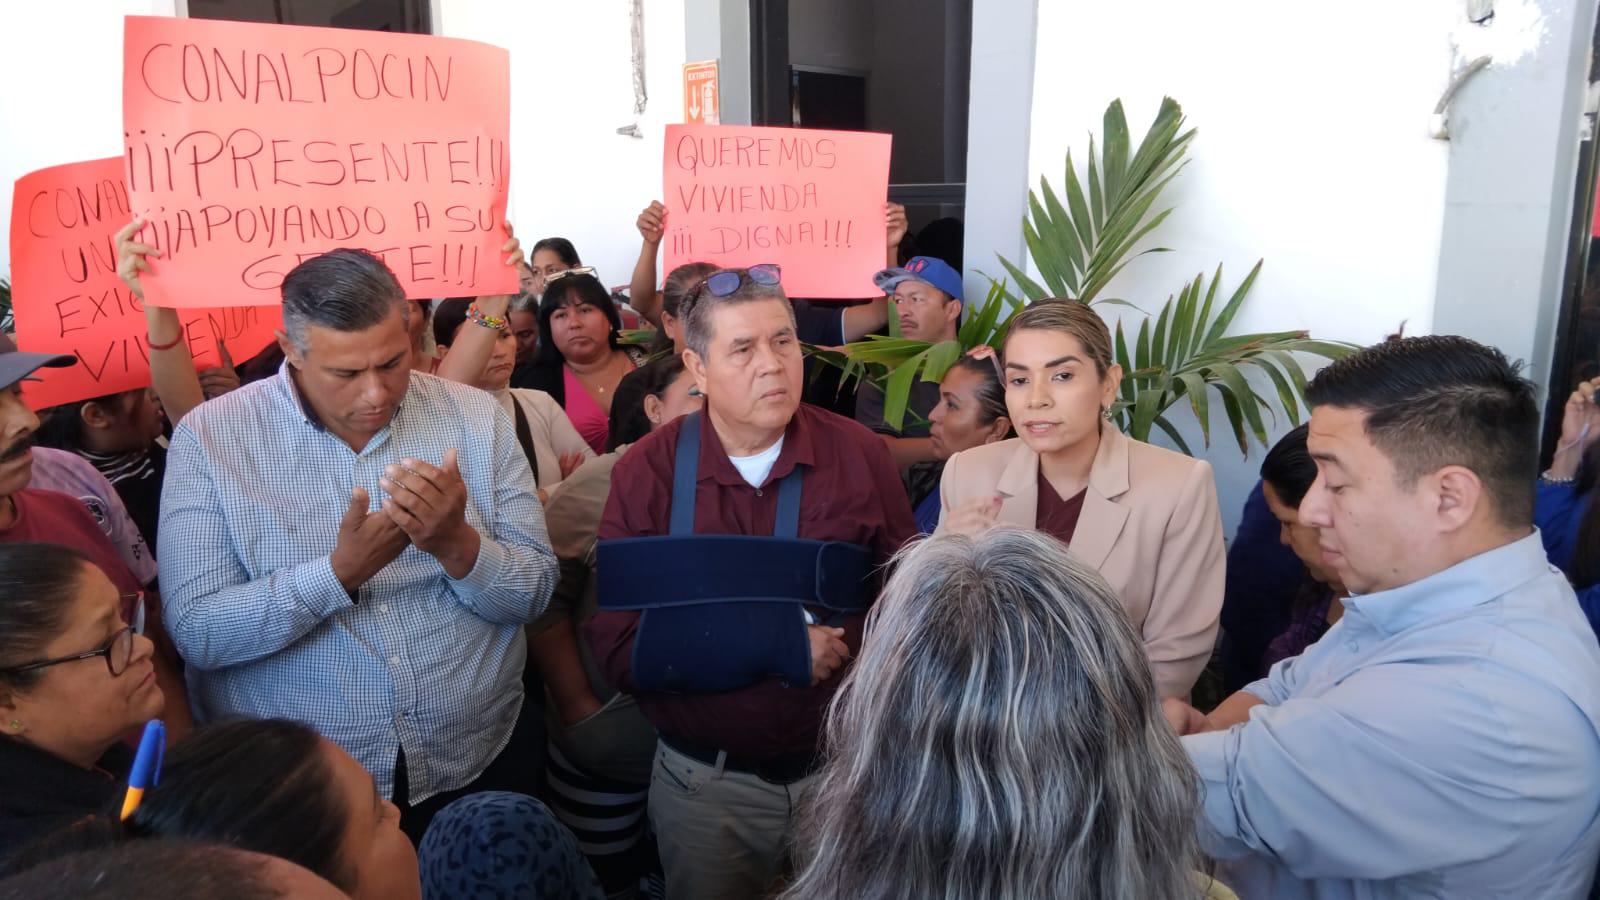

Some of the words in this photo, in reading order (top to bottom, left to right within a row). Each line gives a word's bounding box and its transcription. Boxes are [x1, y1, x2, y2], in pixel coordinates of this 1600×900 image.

[676, 134, 836, 176] QUEREMOS
[28, 178, 132, 239] CONAL
[414, 201, 430, 232] A
[445, 204, 495, 233] SU
[679, 182, 818, 213] VIVIENDA
[61, 235, 117, 284] UN
